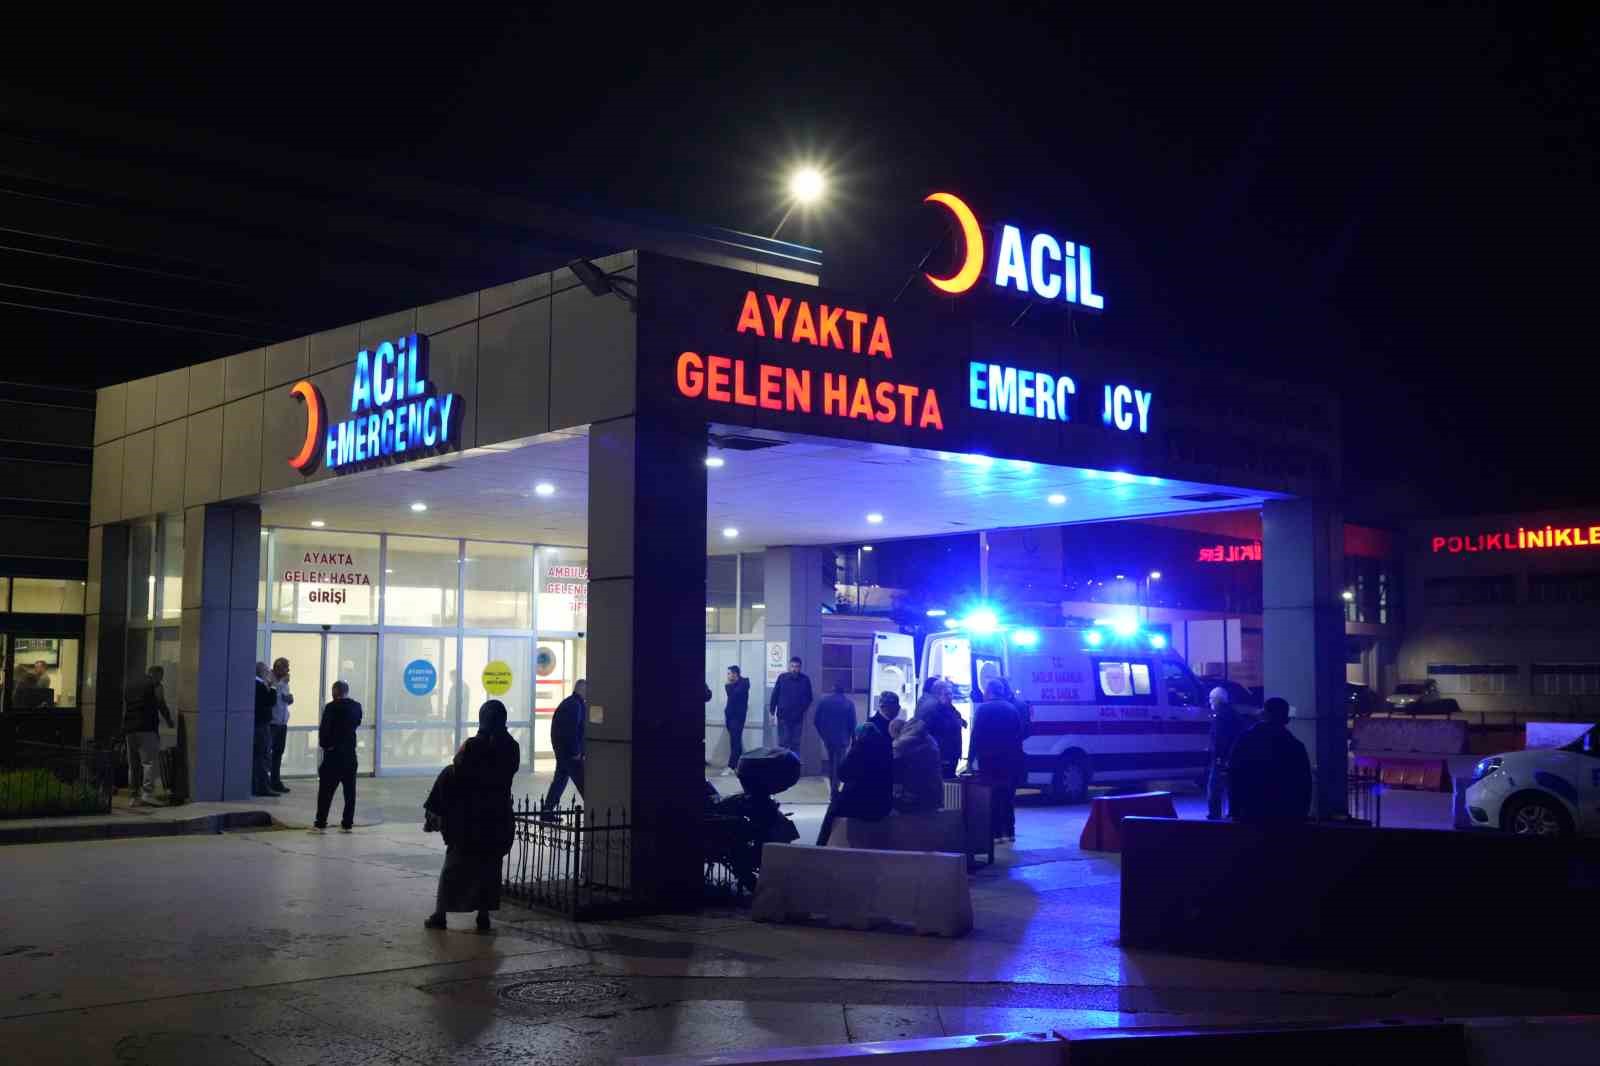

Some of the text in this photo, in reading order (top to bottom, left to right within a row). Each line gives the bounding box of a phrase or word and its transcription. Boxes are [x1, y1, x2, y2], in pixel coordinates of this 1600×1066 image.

[737, 290, 893, 360] AYAKTA
[676, 351, 944, 431] GELEN HASTA
[326, 393, 453, 468] EMERGENCY
[284, 570, 370, 585] GELEN HASTA
[303, 552, 353, 565] AYAKTA
[308, 588, 346, 605] GİRİŞİ
